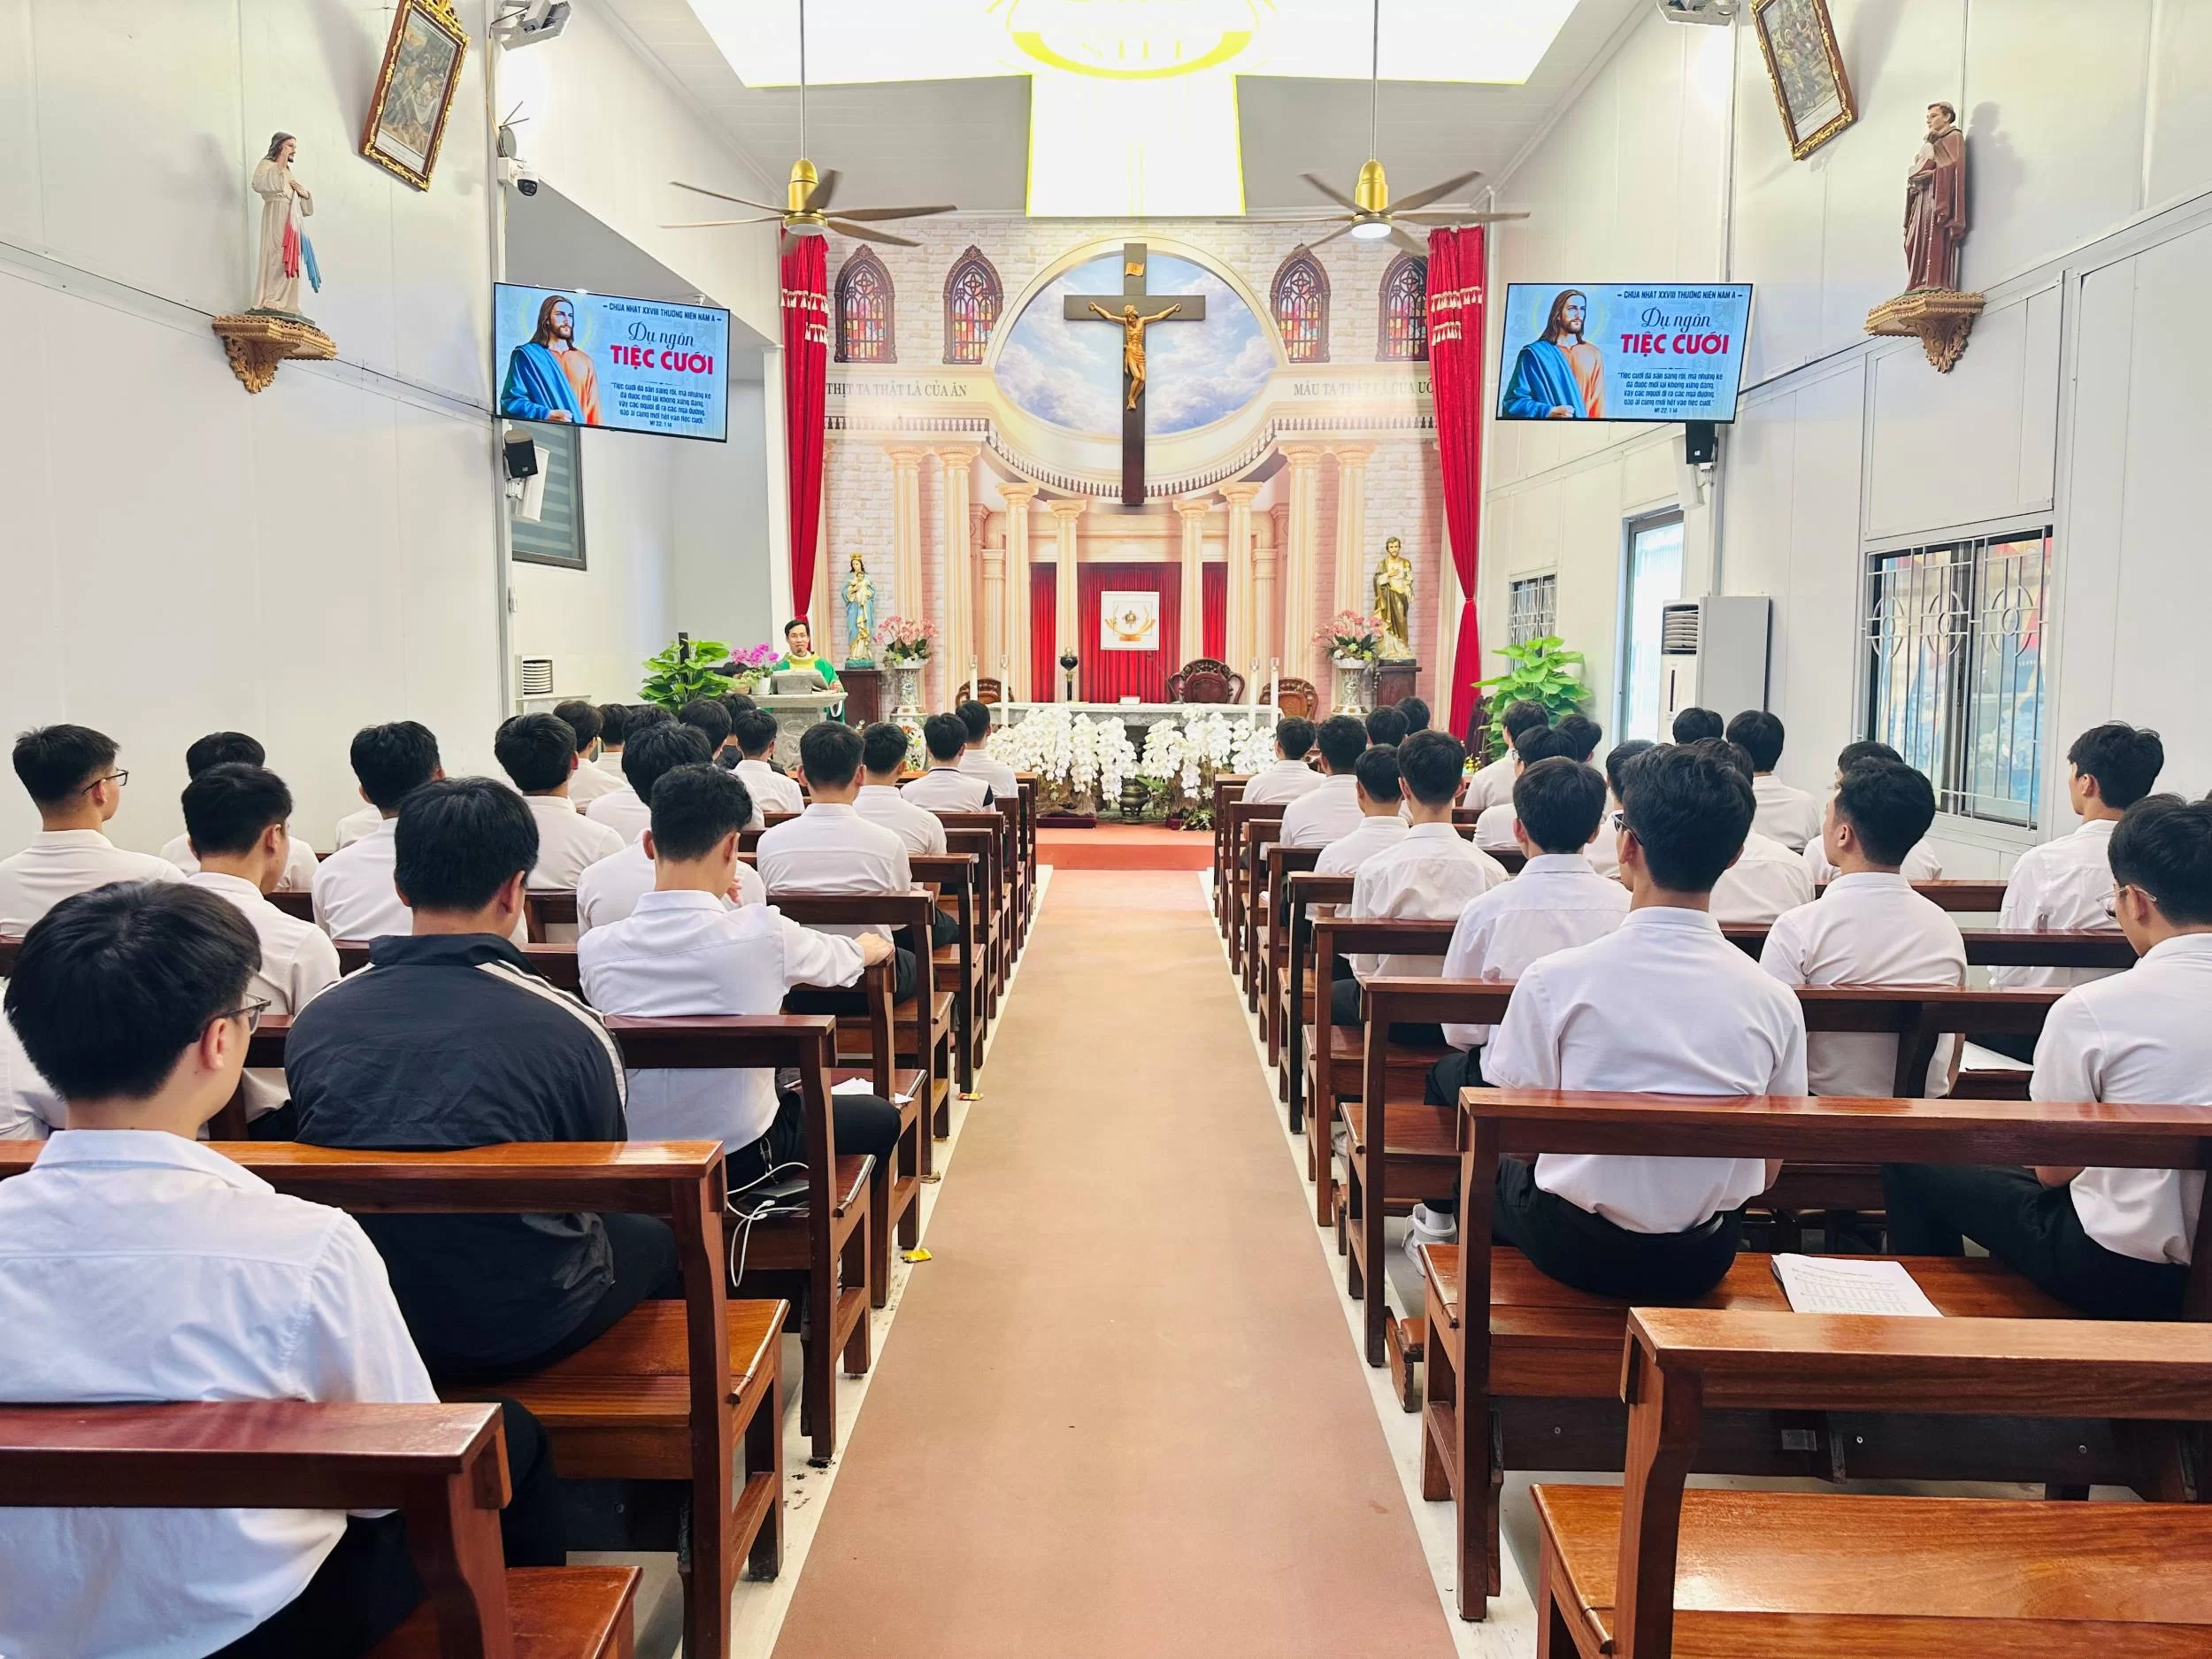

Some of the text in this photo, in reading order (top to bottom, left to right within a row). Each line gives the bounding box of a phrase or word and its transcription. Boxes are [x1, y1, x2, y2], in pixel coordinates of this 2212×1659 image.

[1658, 290, 1676, 299] XXVIII
[1731, 290, 1736, 299] A
[642, 306, 658, 316] XXVIII
[1641, 306, 1670, 330] Dụ
[628, 321, 656, 345] Dụ
[1621, 331, 1730, 357] TIỆC CƯỚI
[611, 344, 713, 375] TIỆC CƯỚI
[856, 382, 871, 396] TA
